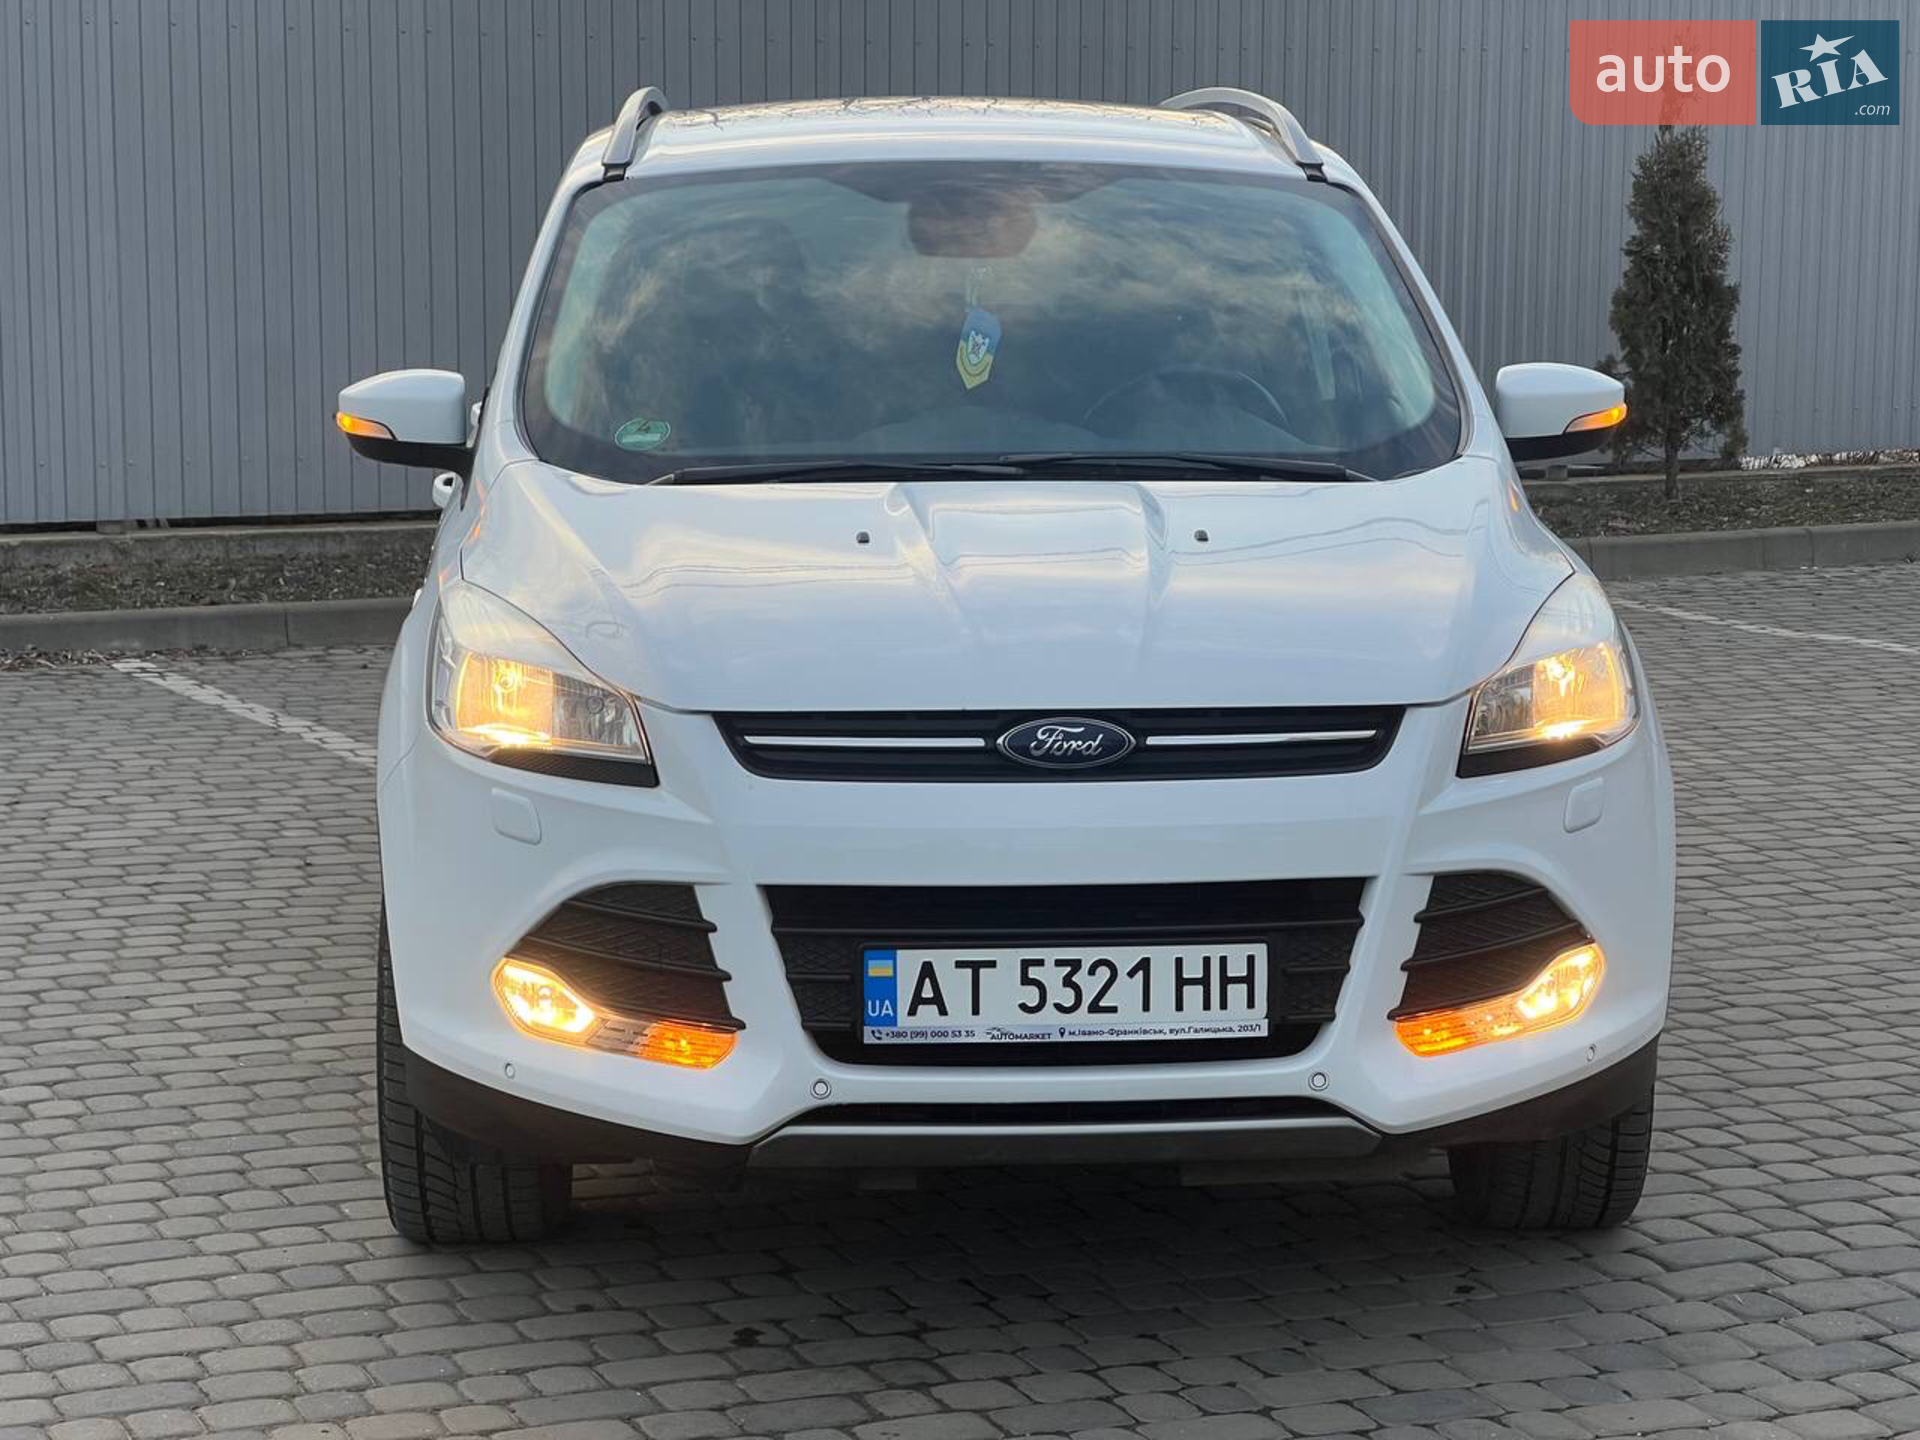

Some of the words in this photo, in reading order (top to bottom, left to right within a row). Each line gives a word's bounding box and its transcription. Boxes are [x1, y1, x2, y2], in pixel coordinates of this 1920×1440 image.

[1030, 725, 1104, 757] Ford
[906, 959, 998, 1017] AT
[1017, 956, 1152, 1016] 5321
[1174, 953, 1256, 1012] HH
[867, 1000, 893, 1018] UA
[910, 1029, 928, 1040] (99)
[930, 1030, 949, 1039] 000
[990, 1031, 1052, 1041] AUTOMARKET
